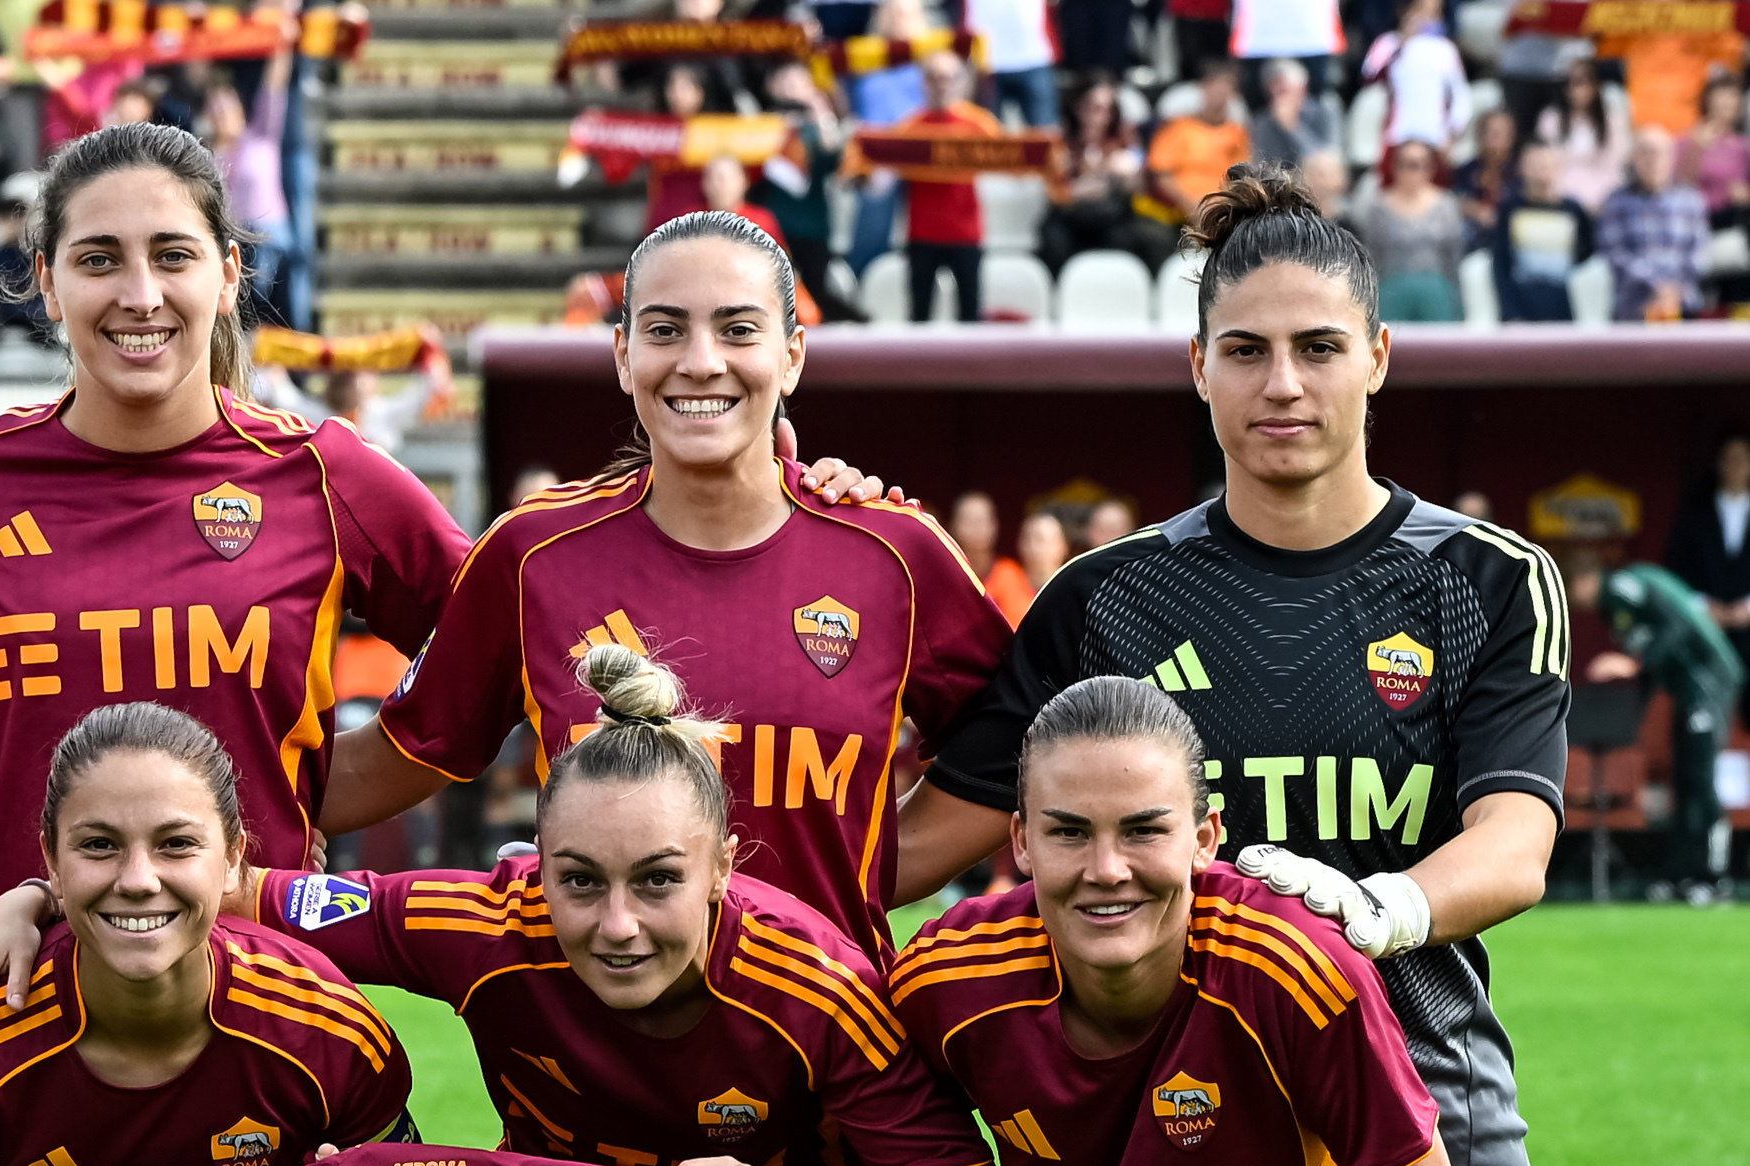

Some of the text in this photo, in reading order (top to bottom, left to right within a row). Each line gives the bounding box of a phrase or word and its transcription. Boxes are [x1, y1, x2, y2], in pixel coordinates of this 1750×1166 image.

[204, 524, 253, 540] ROMA
[219, 540, 239, 549] 1927
[805, 639, 850, 657] ROMA
[1375, 676, 1422, 692] ROMA
[1389, 692, 1407, 701] 1927
[289, 885, 302, 919] ATHORA
[707, 1125, 756, 1138] ROMA
[1165, 1117, 1216, 1135] ROMA
[1182, 1134, 1202, 1146] 1927
